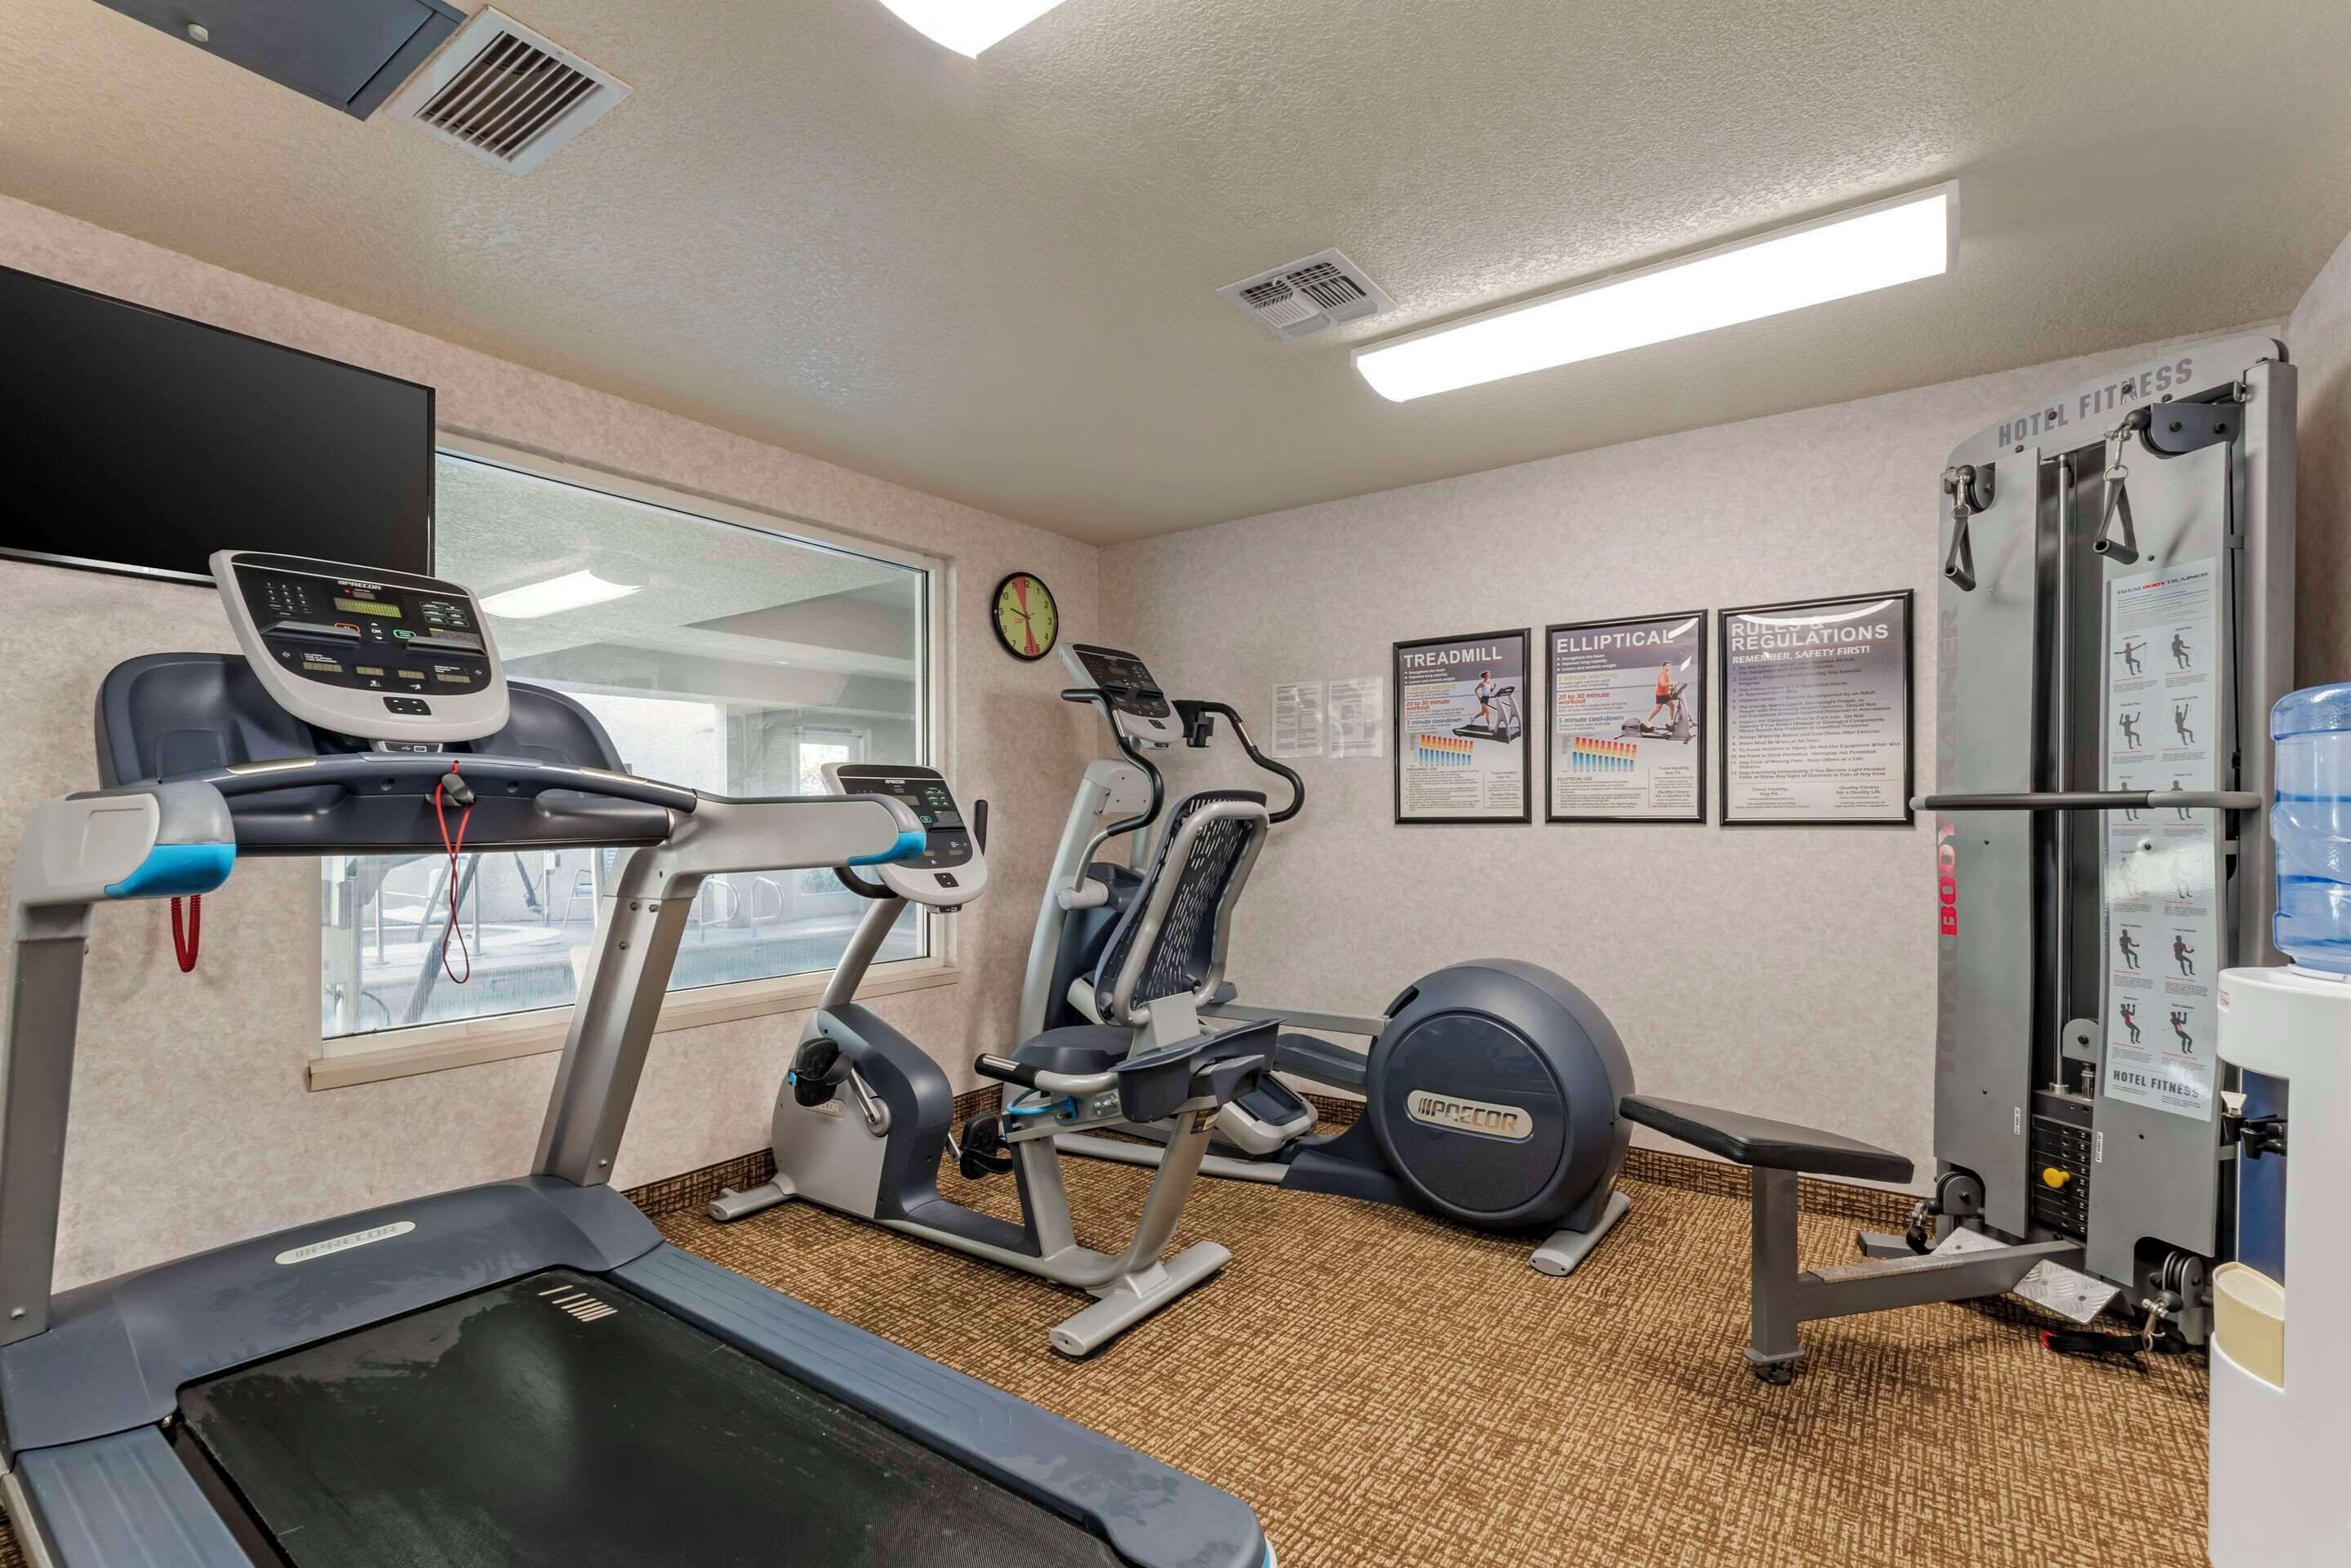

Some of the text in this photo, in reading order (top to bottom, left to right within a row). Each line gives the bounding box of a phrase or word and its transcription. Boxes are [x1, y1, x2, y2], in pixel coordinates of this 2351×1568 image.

[1998, 357, 2193, 448] HOTEL FITNESS
[344, 581, 381, 590] PRECOR
[1012, 582, 1017, 590] 11
[1024, 579, 1030, 588] 12
[2118, 586, 2142, 595] TOTAL
[2167, 572, 2208, 584] TRAINER
[999, 607, 1003, 615] 9
[1045, 601, 1049, 609] 2
[1002, 625, 1007, 633] 8
[1048, 617, 1051, 625] 3
[1557, 629, 1673, 653] ELLIPTICAL
[1731, 624, 1889, 651] REGULATIONS
[1036, 644, 1041, 652] 5
[1404, 646, 1502, 668] TREADMILL
[1732, 645, 1870, 664] REMEMBER, SAFETY FIRST!
[1937, 816, 1958, 936] BODY
[2113, 1070, 2147, 1086] HOTEL
[2151, 1077, 2199, 1099] FITNESS
[819, 1102, 839, 1113] ECOR
[1431, 1099, 1518, 1132] PRECOR
[309, 1224, 398, 1258] PRECOR
